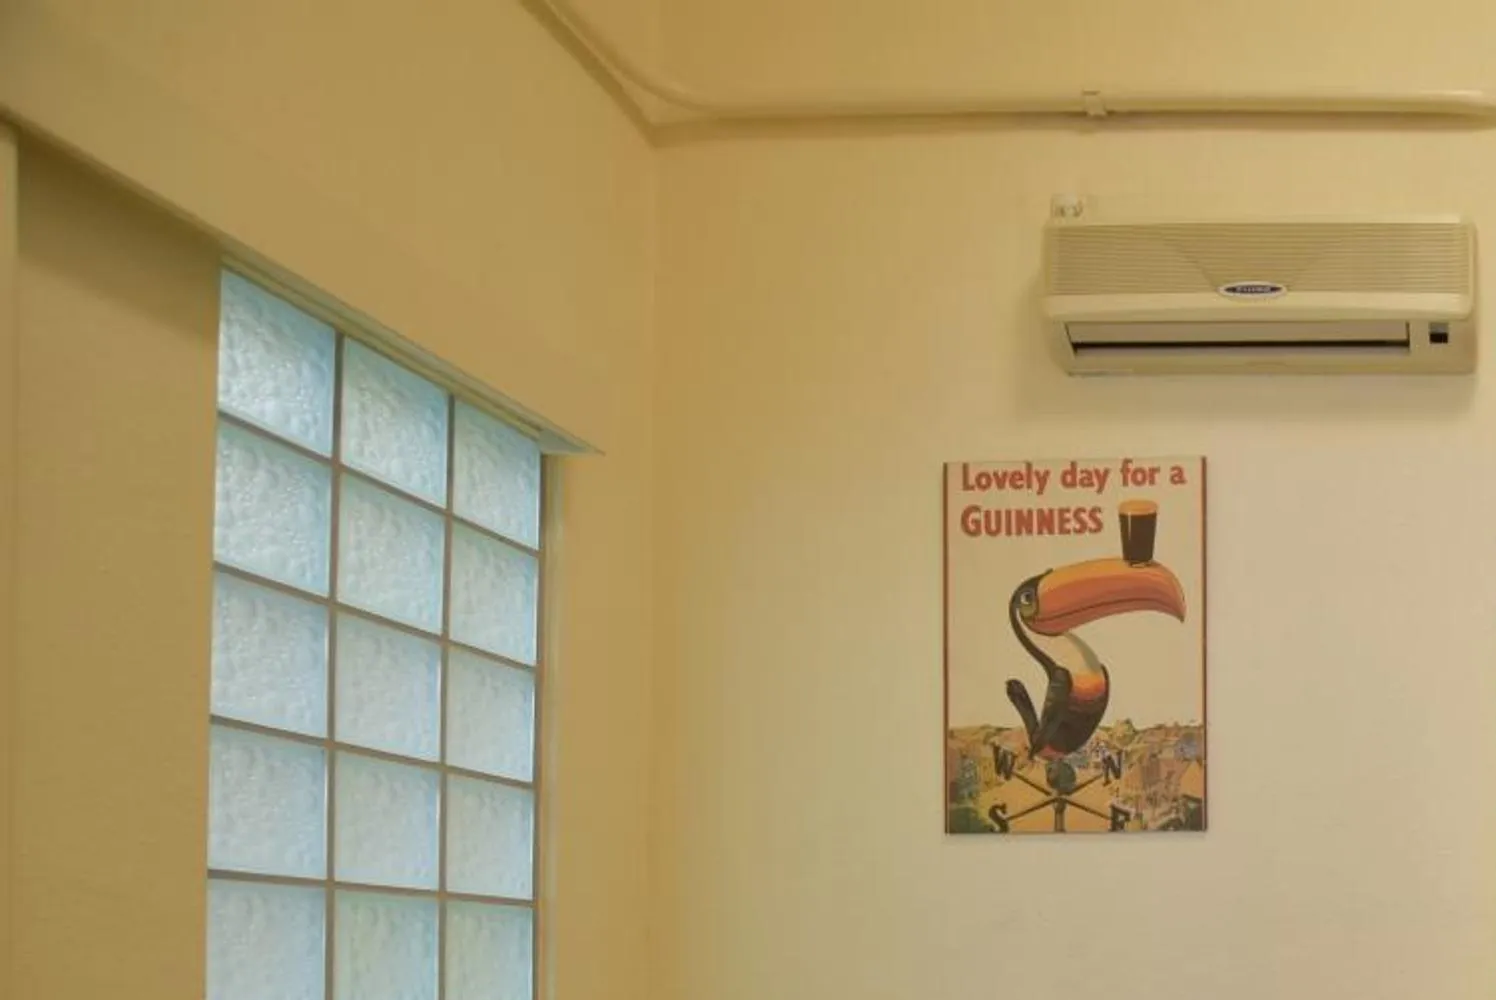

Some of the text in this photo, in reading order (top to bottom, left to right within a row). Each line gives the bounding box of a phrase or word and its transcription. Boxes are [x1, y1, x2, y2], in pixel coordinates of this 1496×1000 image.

[962, 458, 1187, 496] Lovely day for a
[960, 504, 1104, 538] GUINNESS
[1102, 749, 1122, 787] N
[988, 802, 1010, 833] S
